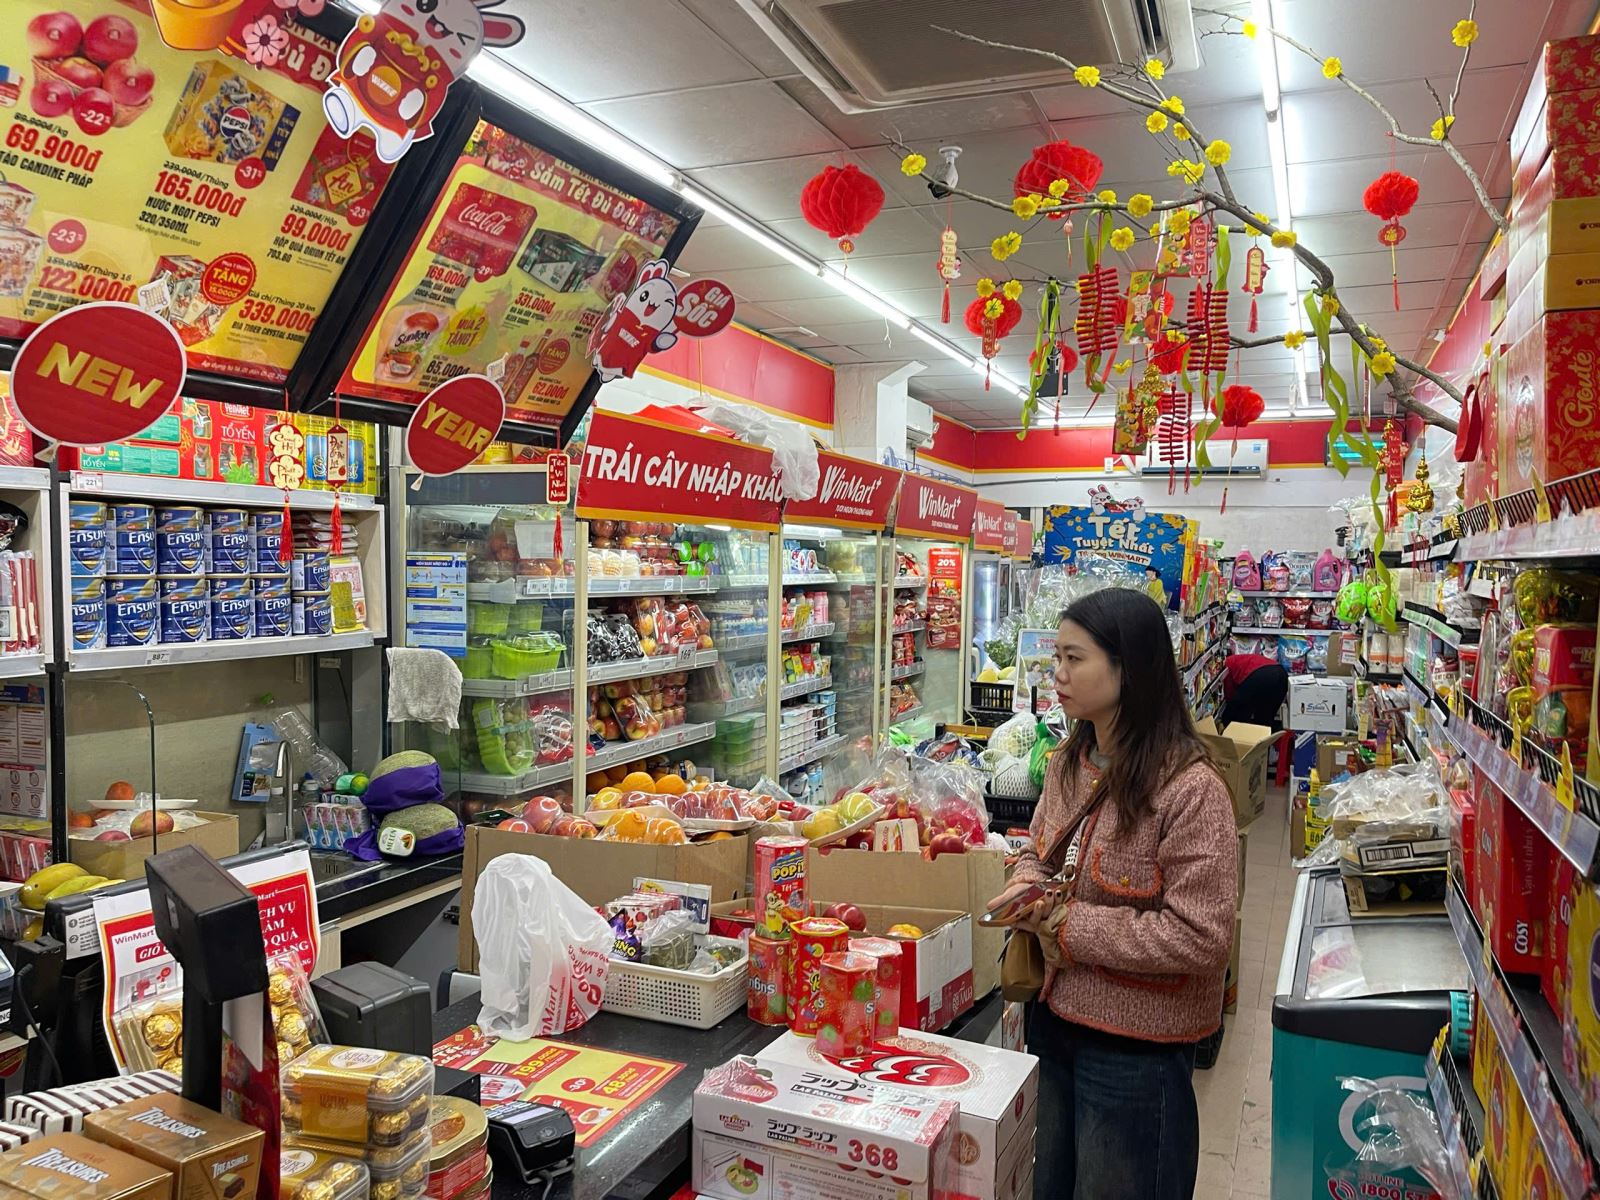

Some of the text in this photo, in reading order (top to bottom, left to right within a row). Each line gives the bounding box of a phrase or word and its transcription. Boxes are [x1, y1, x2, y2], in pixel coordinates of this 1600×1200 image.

[223, 116, 248, 130] PEPSI
[6, 123, 103, 173] 69.900đ
[20, 158, 65, 181] CANDINE
[155, 170, 247, 218] 165.000đ
[196, 211, 221, 227] PEPSI
[281, 214, 352, 251] 99.000đ
[39, 266, 136, 302] 122.000đ
[426, 265, 471, 288] 169.000đ
[514, 292, 556, 315] 331.000đ
[704, 287, 732, 309] GIÁ
[36, 342, 164, 409] NEW
[532, 381, 570, 400] 62.000đ
[421, 401, 492, 453] YEAR
[586, 443, 641, 484] TRÁI
[644, 451, 688, 488] CÂY
[687, 462, 742, 501] NHẬP
[819, 464, 883, 504] WinMart+
[919, 486, 961, 520] WinMart+
[70, 531, 106, 544] Ensur
[129, 532, 155, 544] Ensu
[167, 533, 203, 546] Ensur
[1088, 516, 1140, 542] Tết
[223, 535, 248, 547] Ensu
[1072, 537, 1155, 555] Tuyệt Nhất
[938, 558, 956, 567] 20%
[118, 602, 156, 616] Ensur
[172, 601, 206, 615] Ensur
[259, 901, 296, 920] CH VỤ
[271, 927, 298, 946] QUÀ
[1515, 920, 1528, 955] COSY
[542, 985, 558, 1034] nMart
[513, 1060, 544, 1076] 199
[603, 1081, 626, 1094] 48
[127, 1106, 207, 1139] TREASURES
[22, 1147, 109, 1184] TREASURES
[211, 1154, 249, 1179] TREASURES
[848, 1139, 898, 1171] 368
